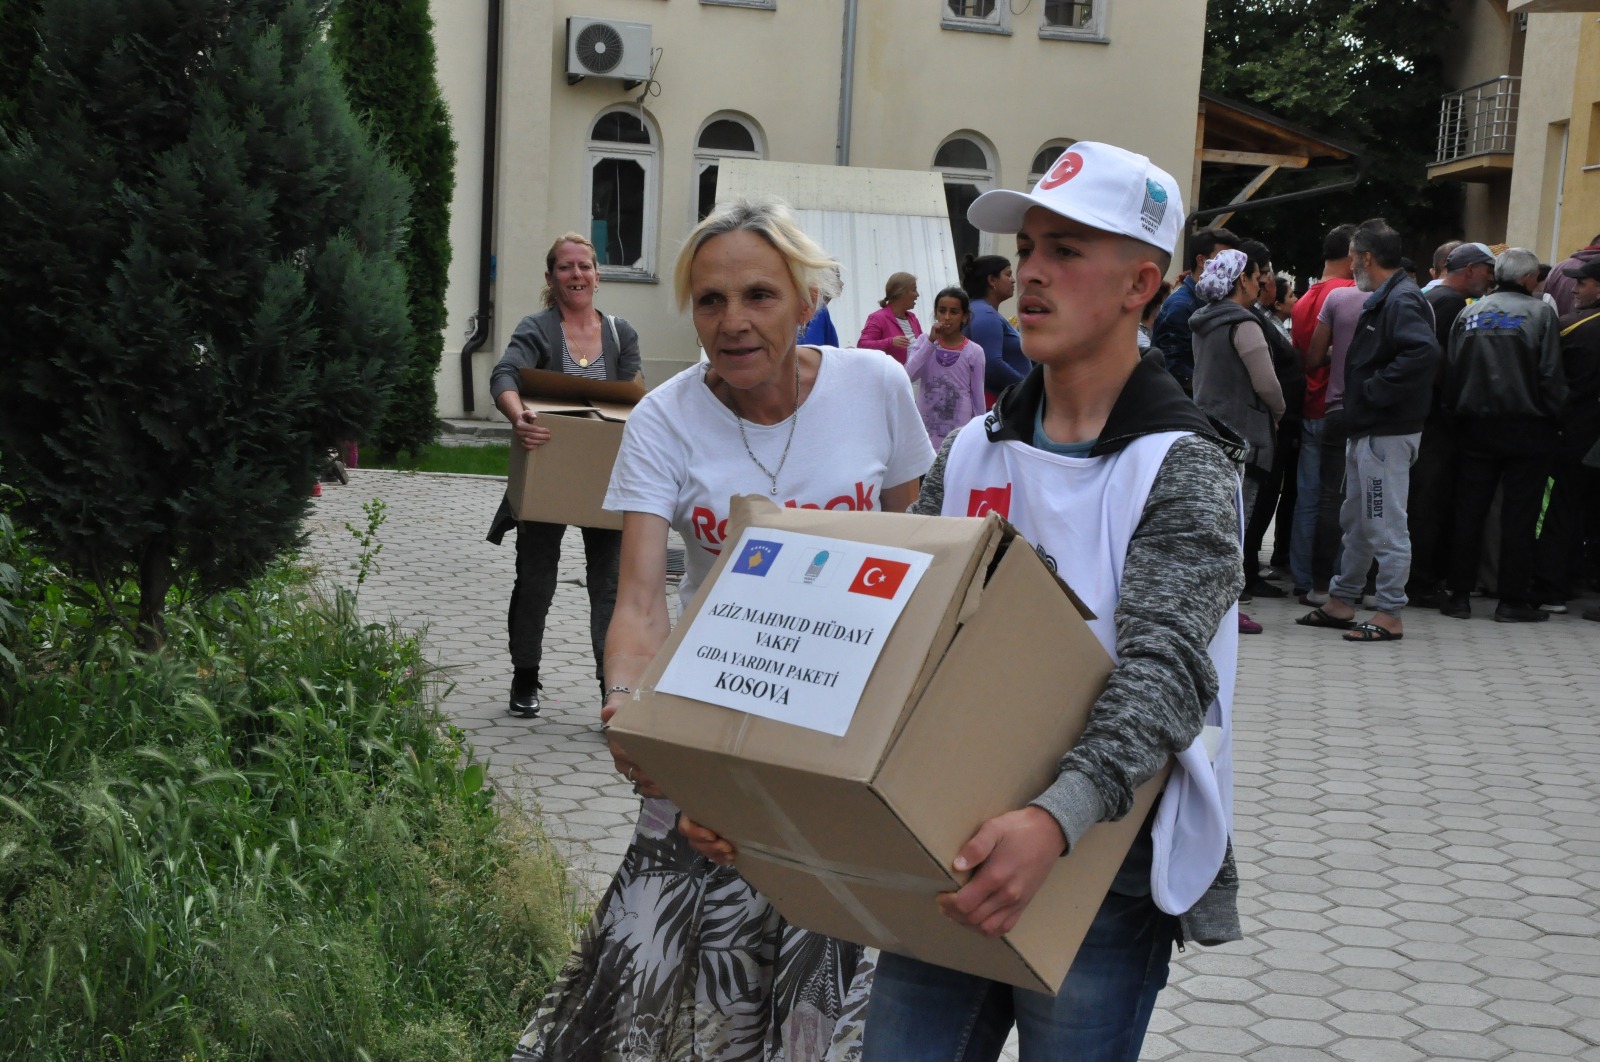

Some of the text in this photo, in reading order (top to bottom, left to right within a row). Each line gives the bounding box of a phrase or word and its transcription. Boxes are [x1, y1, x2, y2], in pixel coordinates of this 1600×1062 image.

[708, 602, 874, 645] AZİZ MAHMUD HÜDAYİ
[755, 631, 801, 653] VAKFİ
[696, 645, 840, 688] GIDA YARDIM PAKETİ
[714, 671, 790, 706] KOSOVA
